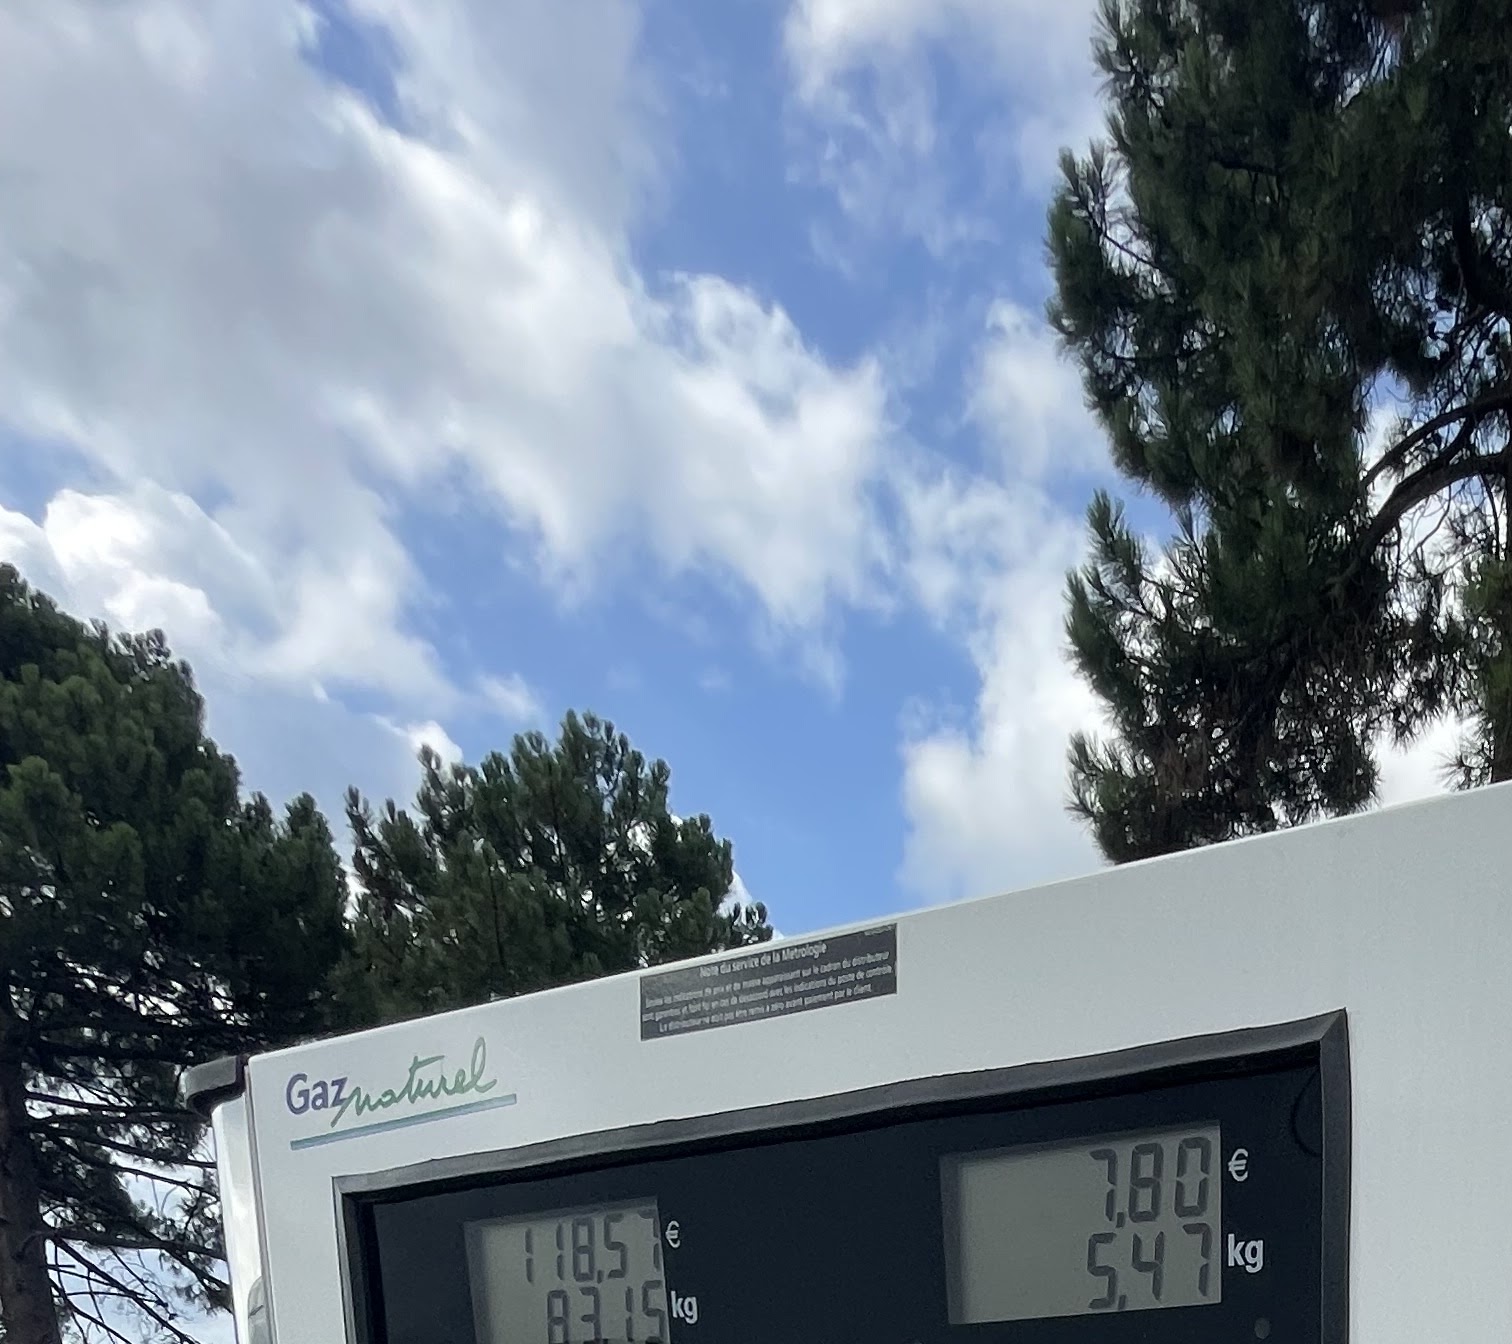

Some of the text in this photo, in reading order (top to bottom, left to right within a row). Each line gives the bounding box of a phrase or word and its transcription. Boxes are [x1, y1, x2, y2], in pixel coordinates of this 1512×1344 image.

[286, 1036, 498, 1128] Gaz naturel
[1227, 1149, 1249, 1181] €
[665, 1220, 681, 1248] €
[1227, 1233, 1264, 1273] kg
[671, 1290, 698, 1325] kg
